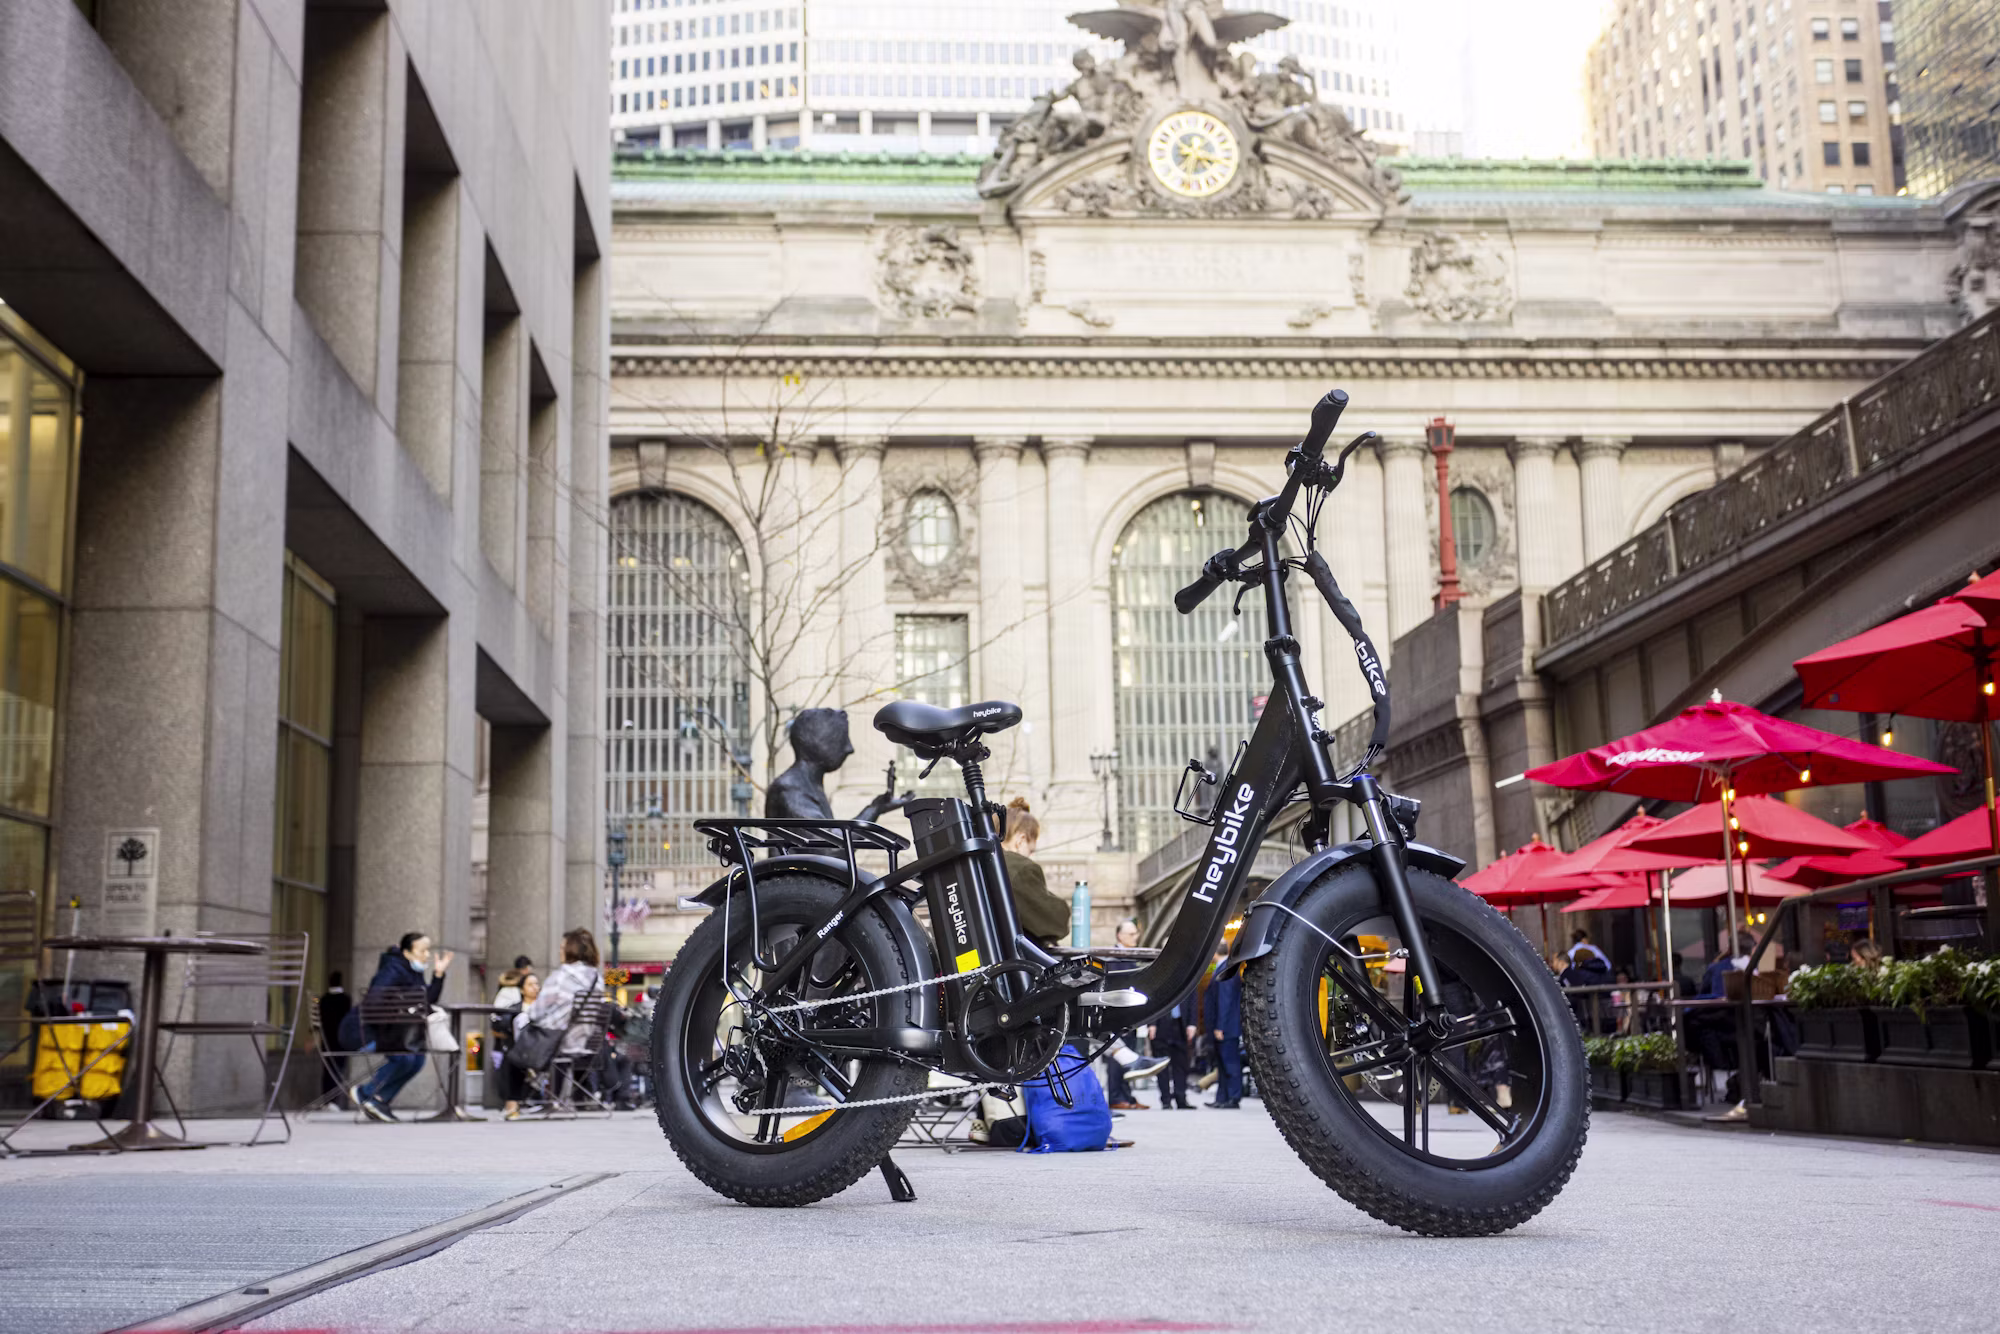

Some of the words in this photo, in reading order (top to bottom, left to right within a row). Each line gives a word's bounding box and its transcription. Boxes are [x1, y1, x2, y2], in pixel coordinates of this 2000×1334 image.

[973, 707, 1002, 718] heybike
[1192, 783, 1254, 903] heybike
[816, 910, 844, 939] Ranger
[946, 882, 967, 944] heybike
